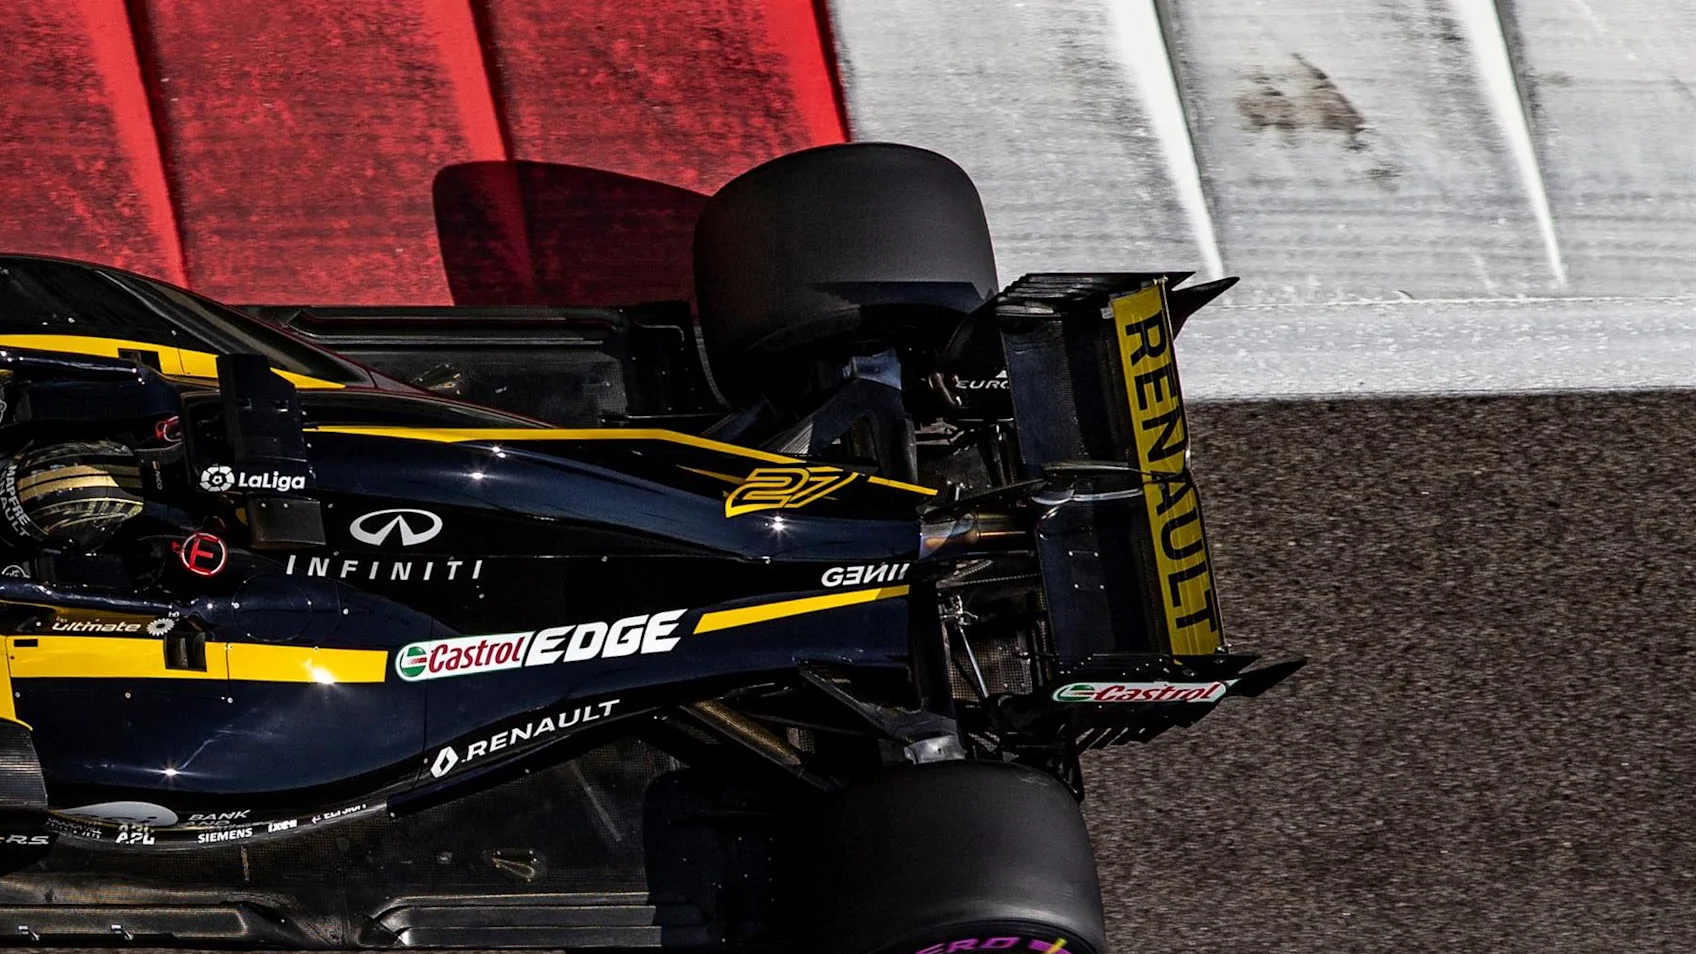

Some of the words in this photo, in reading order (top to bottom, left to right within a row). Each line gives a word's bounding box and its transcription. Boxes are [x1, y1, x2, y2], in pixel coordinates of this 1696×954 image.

[238, 471, 305, 491] LaLiga
[1124, 313, 1218, 634] RENAULT
[7, 464, 31, 526] MAPFRE
[725, 466, 859, 518] 27
[285, 554, 482, 580] INFINITI
[51, 618, 142, 633] ultimate
[427, 635, 526, 673] Castrol
[524, 608, 689, 667] EDGE
[1095, 683, 1226, 701] Castrol
[466, 698, 620, 761] RENAULT
[187, 809, 251, 822] BANK
[197, 827, 253, 844] SIEMENS
